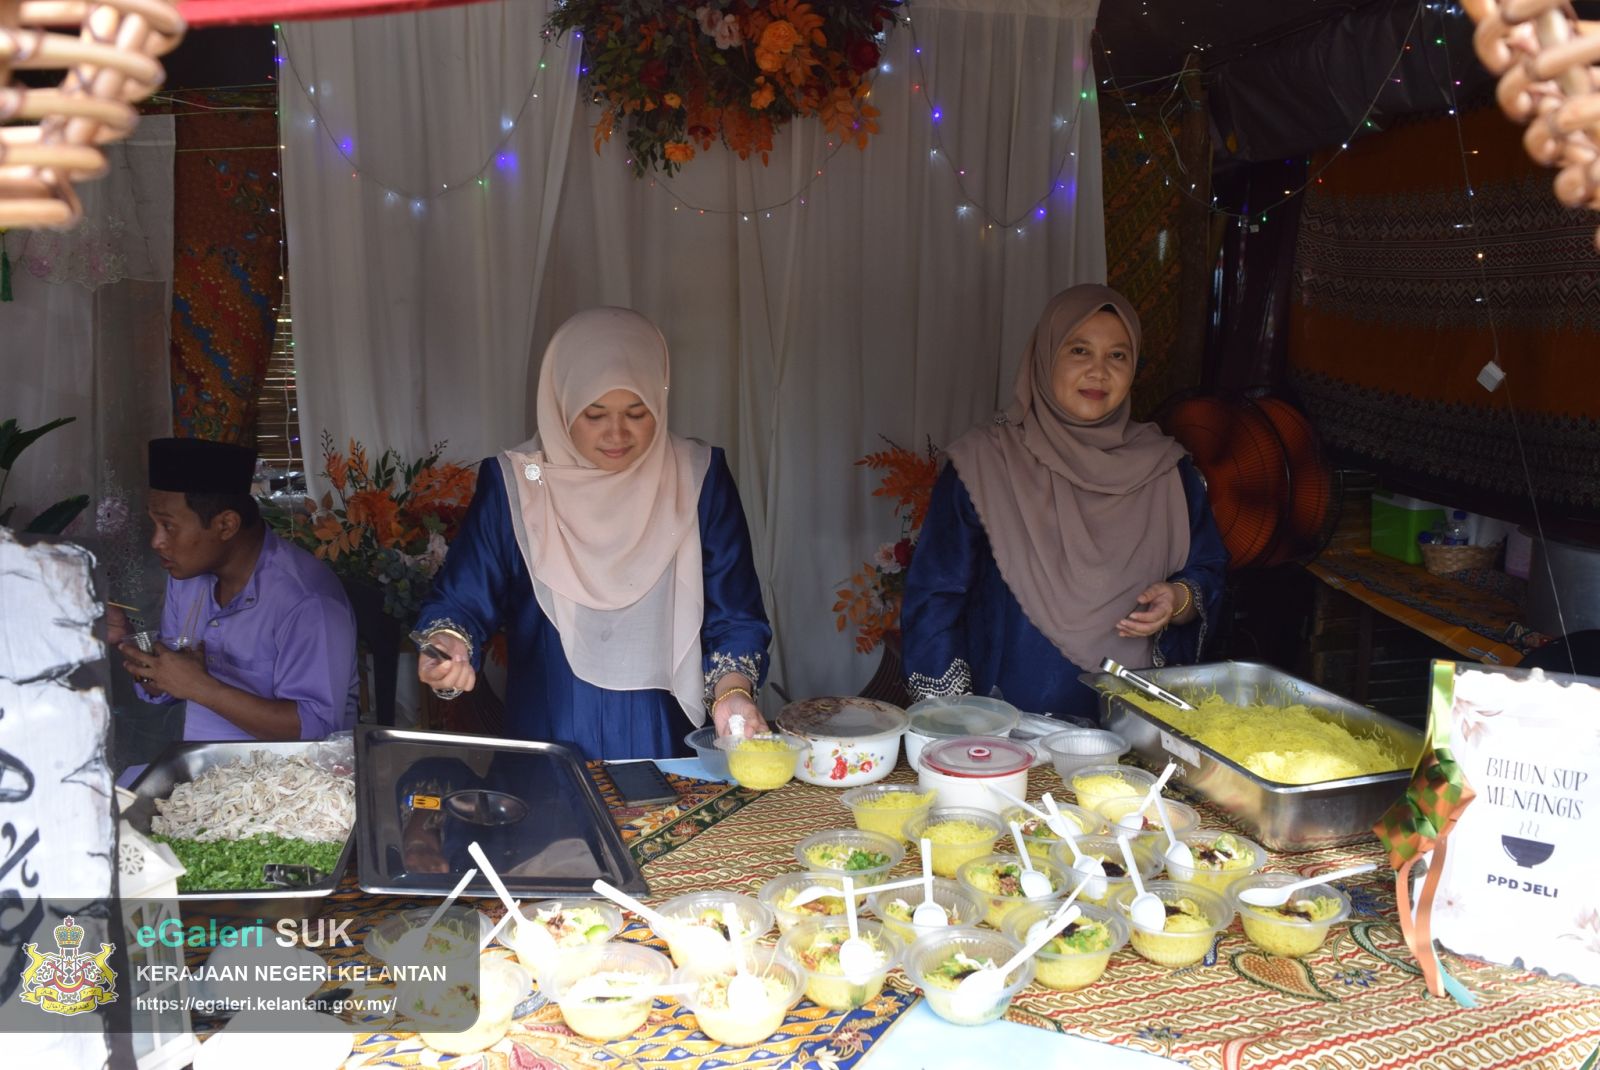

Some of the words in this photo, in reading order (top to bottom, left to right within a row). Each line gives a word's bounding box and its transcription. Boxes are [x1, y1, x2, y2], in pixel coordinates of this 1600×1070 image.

[1486, 757, 1547, 786] BIHUN
[1551, 767, 1588, 792] SUP
[1486, 784, 1584, 820] MENANGIS
[1487, 874, 1519, 890] PPD
[1522, 881, 1559, 898] JELI
